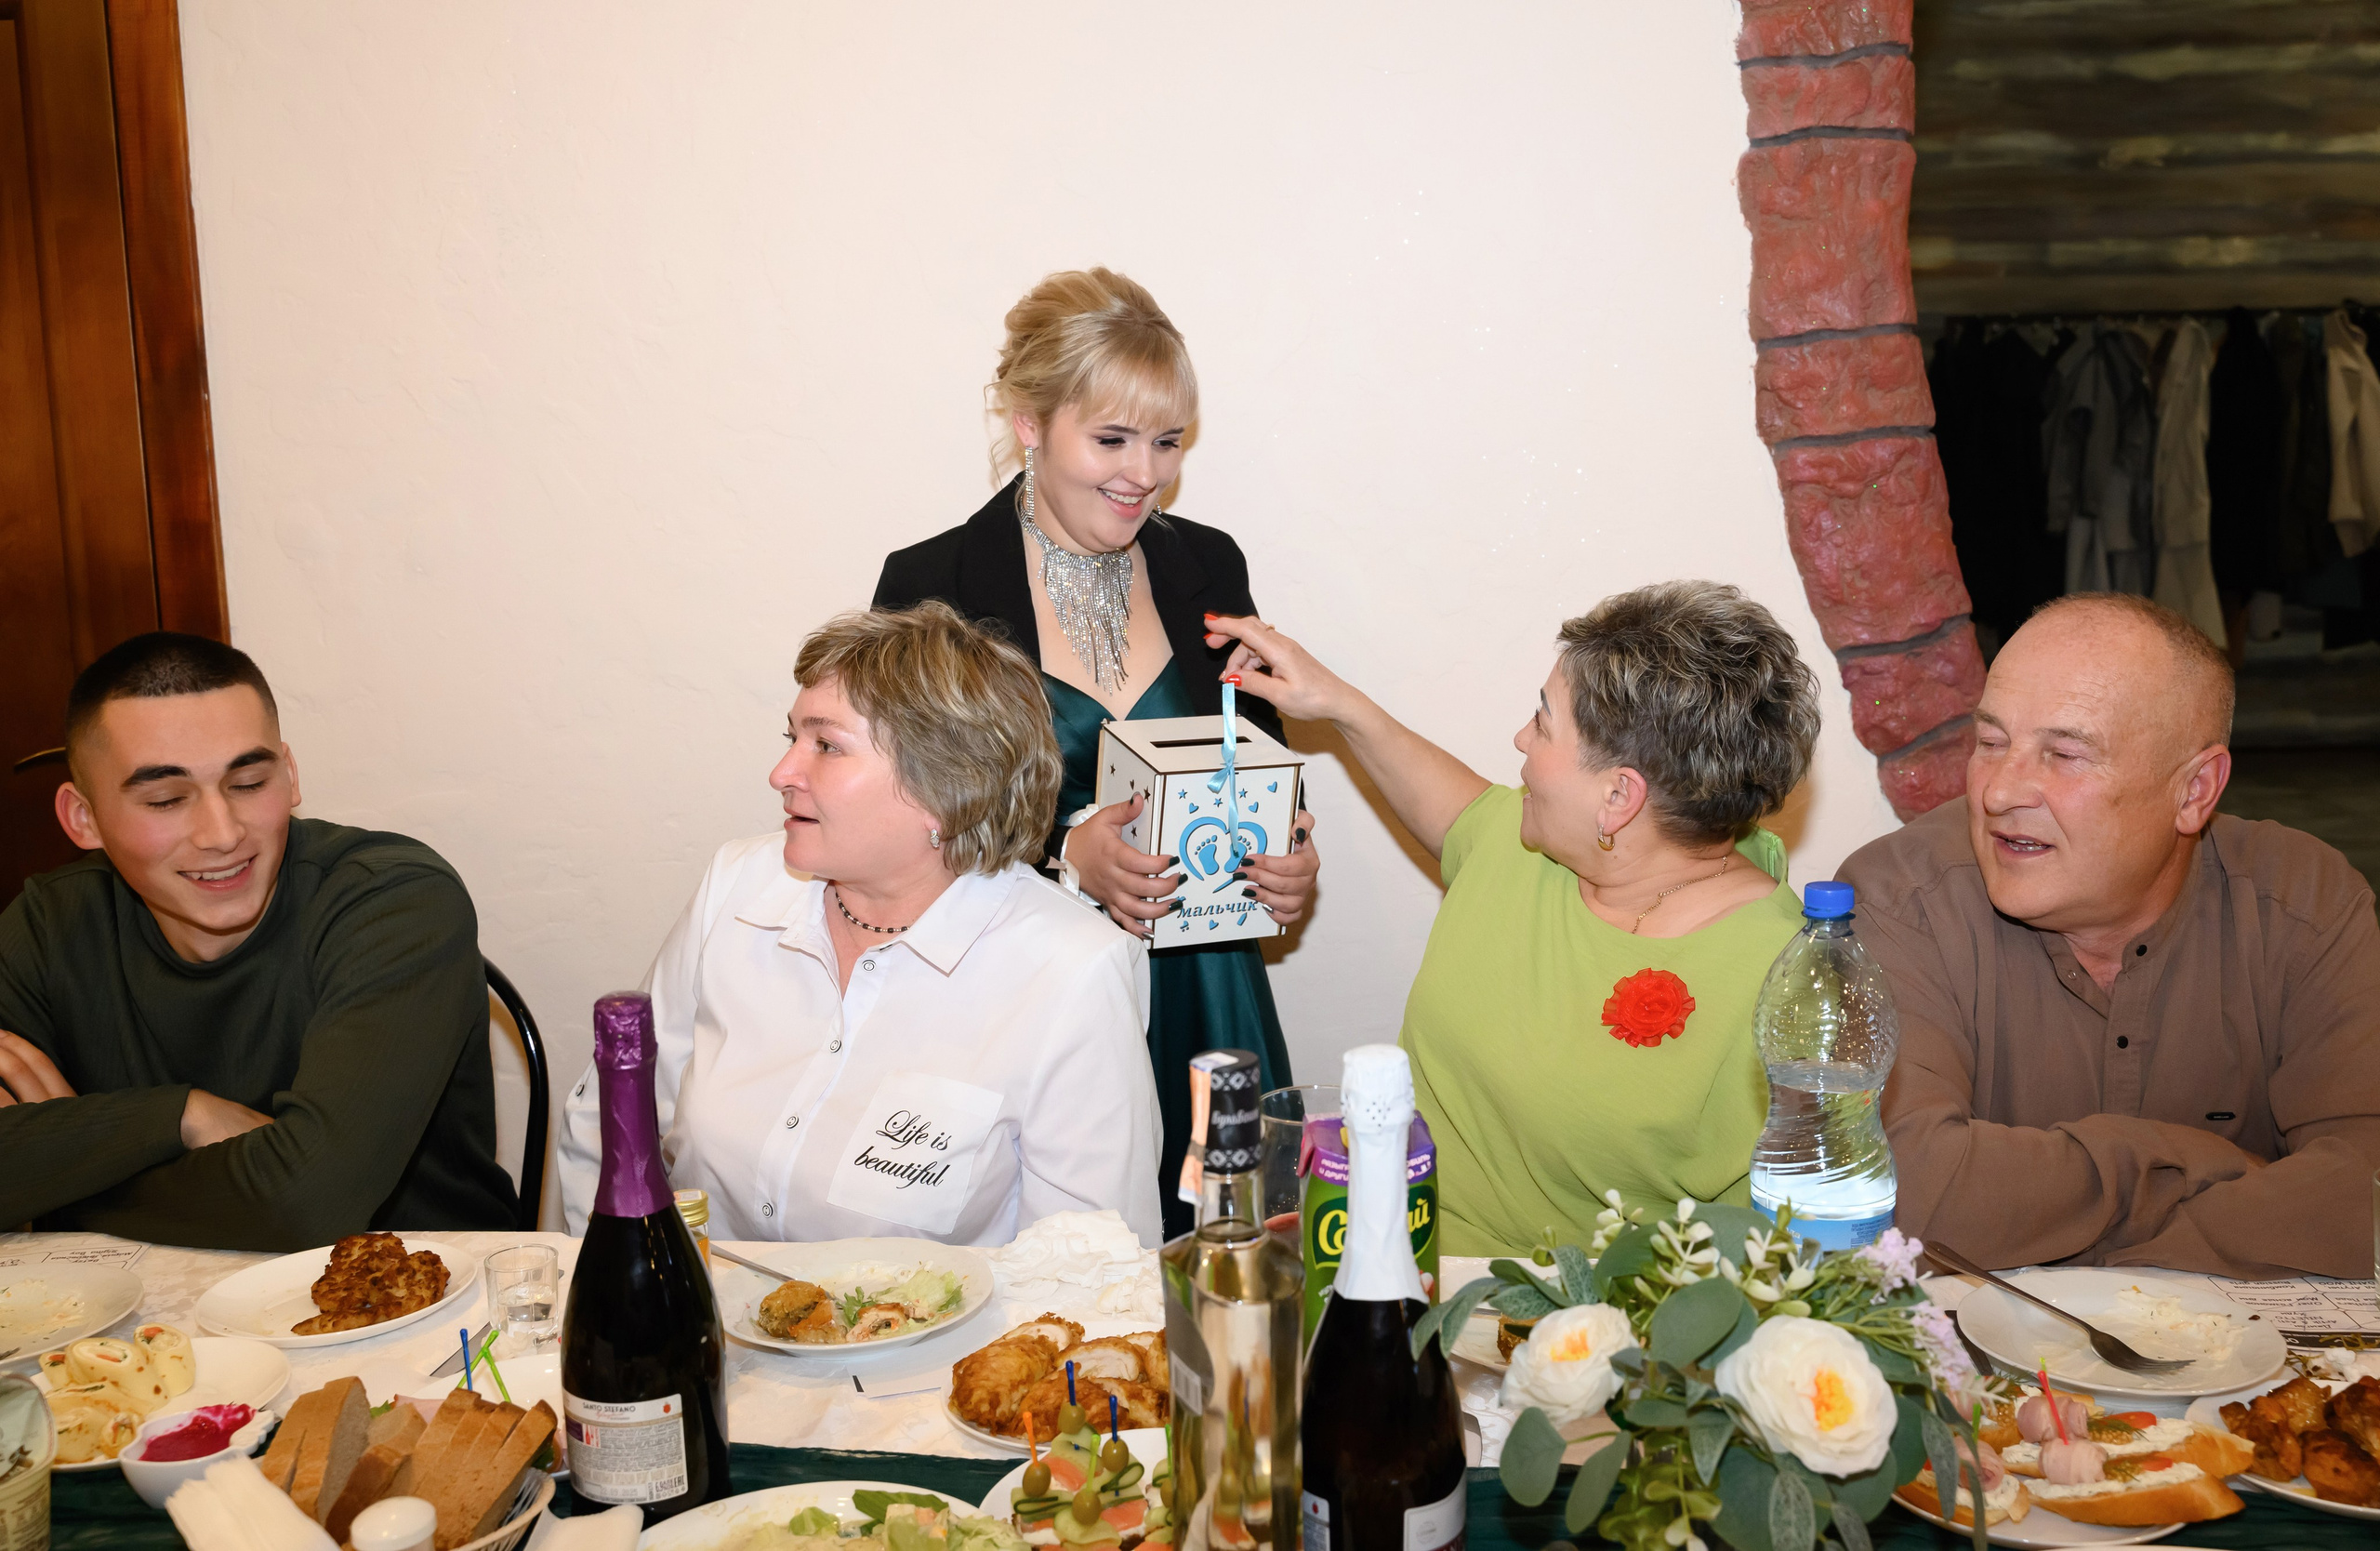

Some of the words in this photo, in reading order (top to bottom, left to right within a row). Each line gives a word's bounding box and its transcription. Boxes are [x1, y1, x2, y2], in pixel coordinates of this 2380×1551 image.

[1176, 900, 1259, 919] мальчик
[875, 1109, 932, 1150] Life
[931, 1132, 952, 1151] is
[853, 1146, 951, 1189] beautiful
[582, 1402, 602, 1412] SANTO
